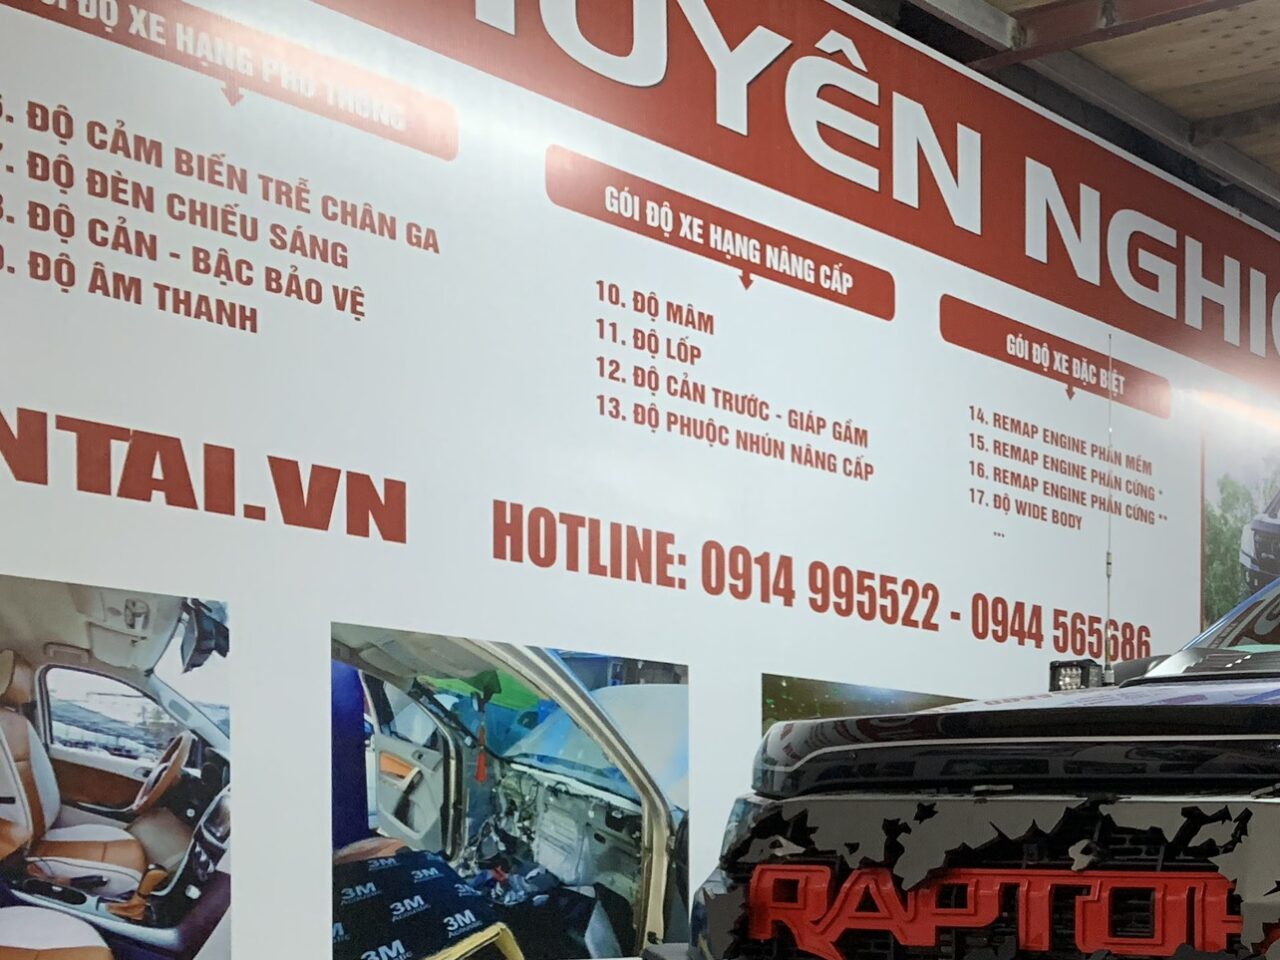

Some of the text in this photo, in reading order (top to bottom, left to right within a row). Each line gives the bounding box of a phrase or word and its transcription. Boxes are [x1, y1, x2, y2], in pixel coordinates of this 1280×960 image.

[129, 4, 166, 46] XE
[175, 22, 254, 77] HẠNG
[26, 149, 74, 194] ĐỘ
[86, 168, 155, 213] ĐÈN
[166, 193, 258, 242] CHIẾU
[269, 222, 348, 269] SÁNG
[87, 119, 163, 169] CẢM
[174, 147, 248, 195] BIẾN
[257, 174, 311, 214] TRỄ
[320, 195, 397, 241] CHÂN
[405, 221, 440, 254] GA
[27, 200, 76, 244] ĐỘ
[87, 215, 157, 261] CẢN
[192, 246, 254, 287] BẬC
[264, 264, 323, 305] BẢO
[331, 285, 366, 321] VỆ
[604, 185, 854, 296] GÓI ĐỘ XE HẠNG NÂNG CẤP
[27, 250, 76, 293] ĐỘ
[87, 260, 143, 305] ÂM
[153, 282, 258, 334] THANH
[595, 279, 716, 335] 10. ĐỘ MÂM
[595, 317, 702, 366] 11. ĐỘ LỐP
[1006, 333, 1030, 361] GÓI
[1031, 342, 1050, 371] ĐỘ
[1052, 350, 1070, 376] XE
[595, 355, 627, 383] 12.
[632, 365, 660, 397] ĐỘ
[666, 371, 706, 405] CẢN
[711, 386, 770, 422] TRƯỚC
[787, 408, 827, 437] GIÁP
[595, 394, 875, 482] 13. ĐỘ PHUỘC NHÚN NÂNG CẤP
[968, 405, 989, 426] 14.
[992, 412, 1039, 440] REMAP
[1042, 427, 1088, 457] ENGINE
[968, 432, 989, 453] 15.
[992, 439, 1039, 466] REMAP
[1042, 454, 1088, 482] ENGINE
[968, 460, 989, 480] 16.
[992, 466, 1039, 493] REMAP
[1042, 480, 1088, 508] ENGINE
[968, 487, 1083, 531] 17. ĐỘ WIDE BODY
[492, 498, 687, 591] HOTLINE:
[701, 539, 795, 608] 0914
[808, 559, 939, 632] 995522
[970, 592, 1044, 650] 0944
[1051, 608, 1152, 662] 565686
[341, 882, 377, 900] 3M
[390, 895, 425, 915] 3M
[443, 909, 476, 931] 3M
